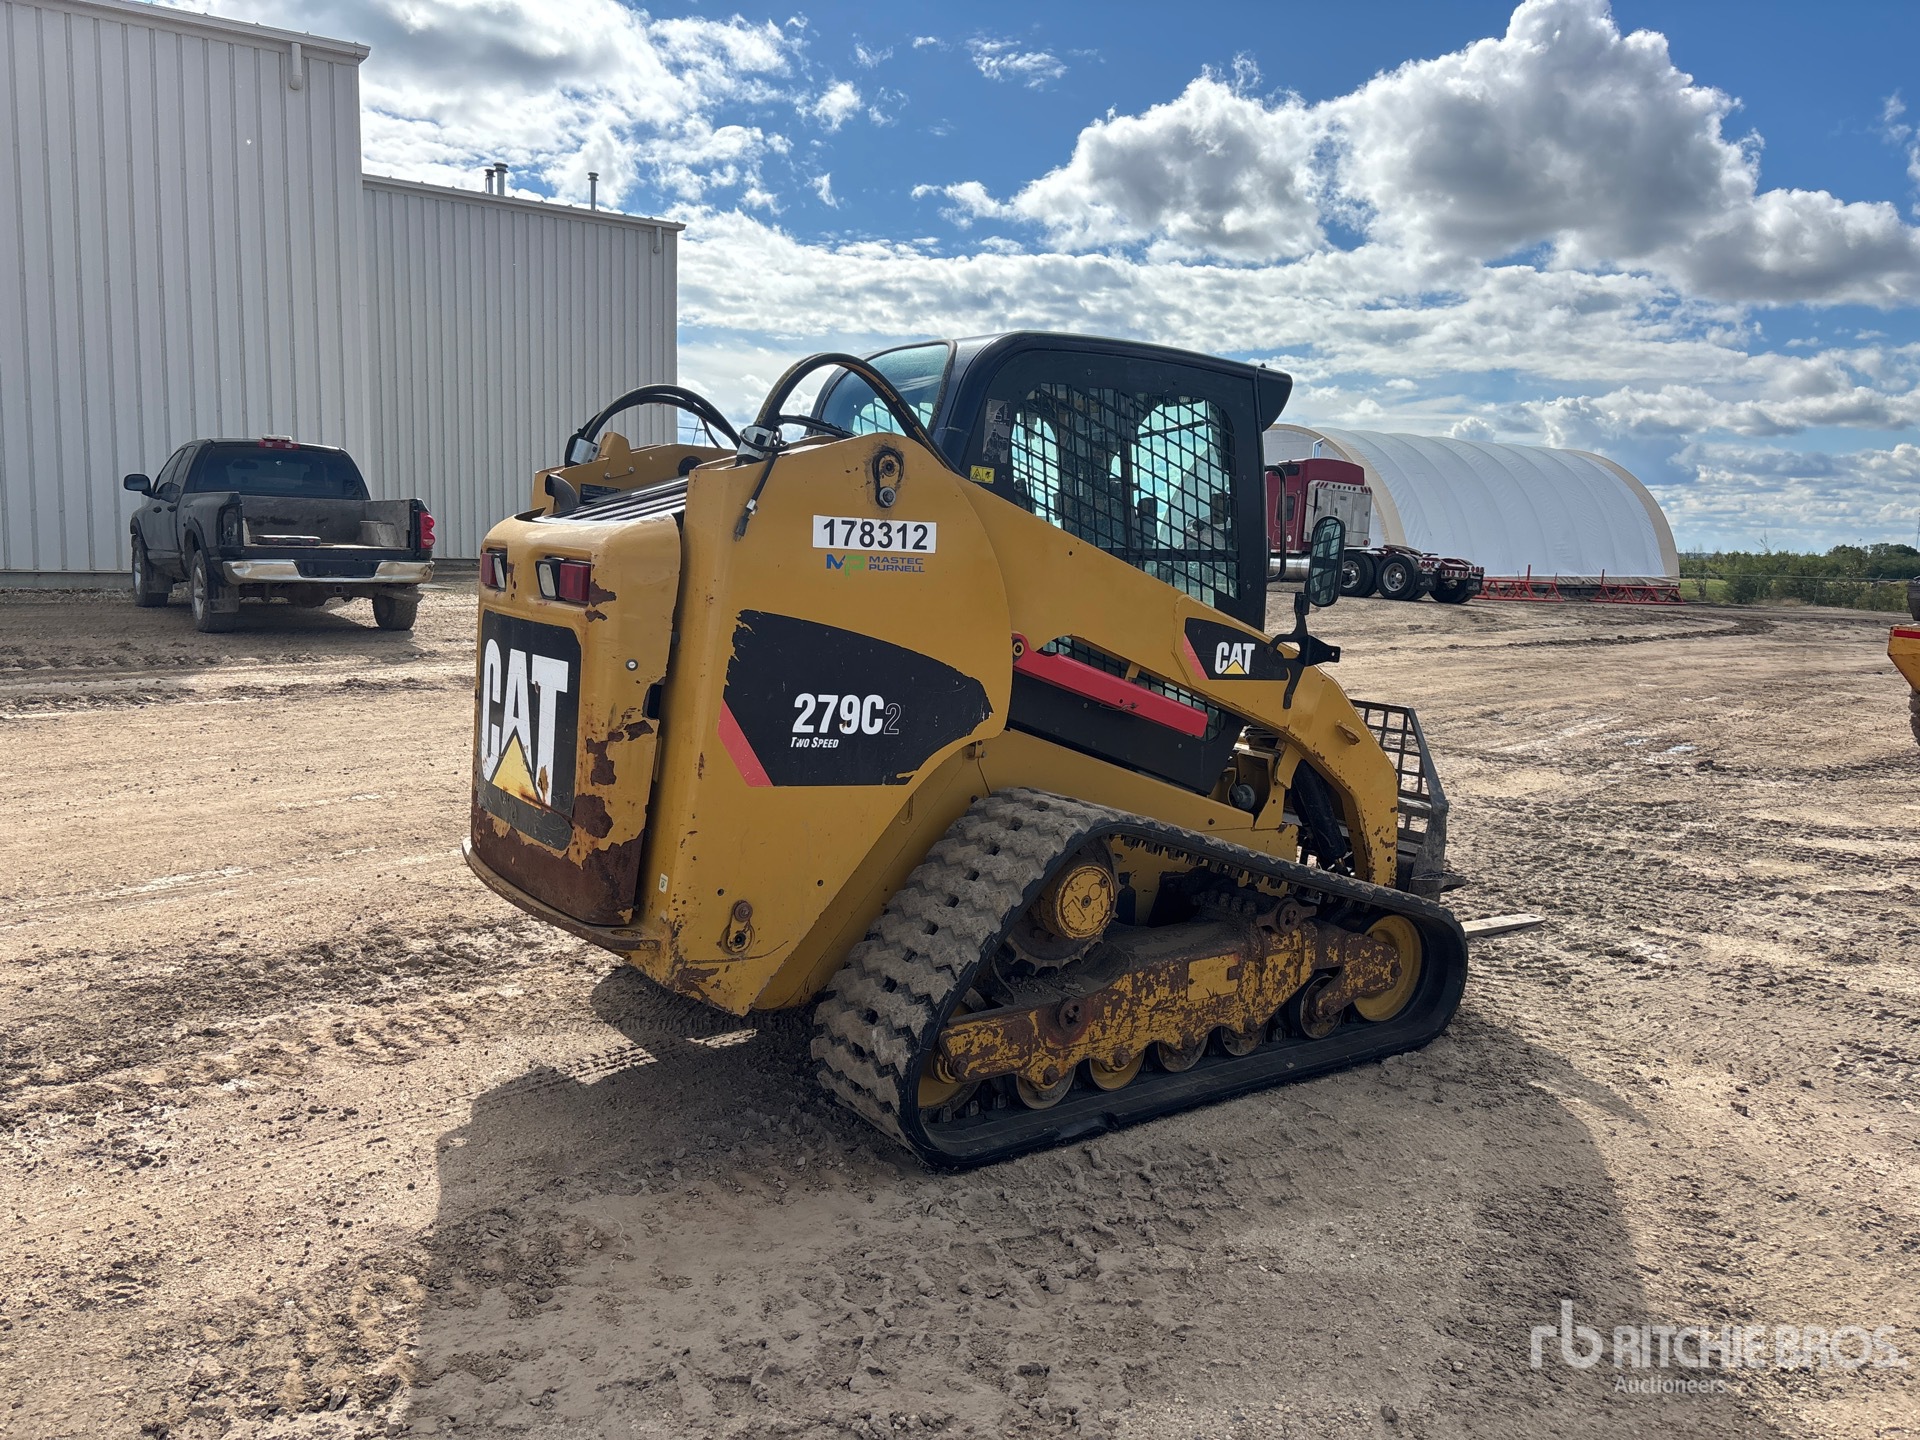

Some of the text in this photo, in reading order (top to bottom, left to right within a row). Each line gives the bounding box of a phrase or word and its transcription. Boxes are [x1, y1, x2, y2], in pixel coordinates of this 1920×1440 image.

[823, 518, 929, 551] 178312
[868, 555, 924, 566] MASTEC
[868, 563, 925, 573] PURNELL
[1214, 641, 1256, 675] CAT
[481, 638, 569, 807] CAT
[792, 693, 902, 735] 279C2
